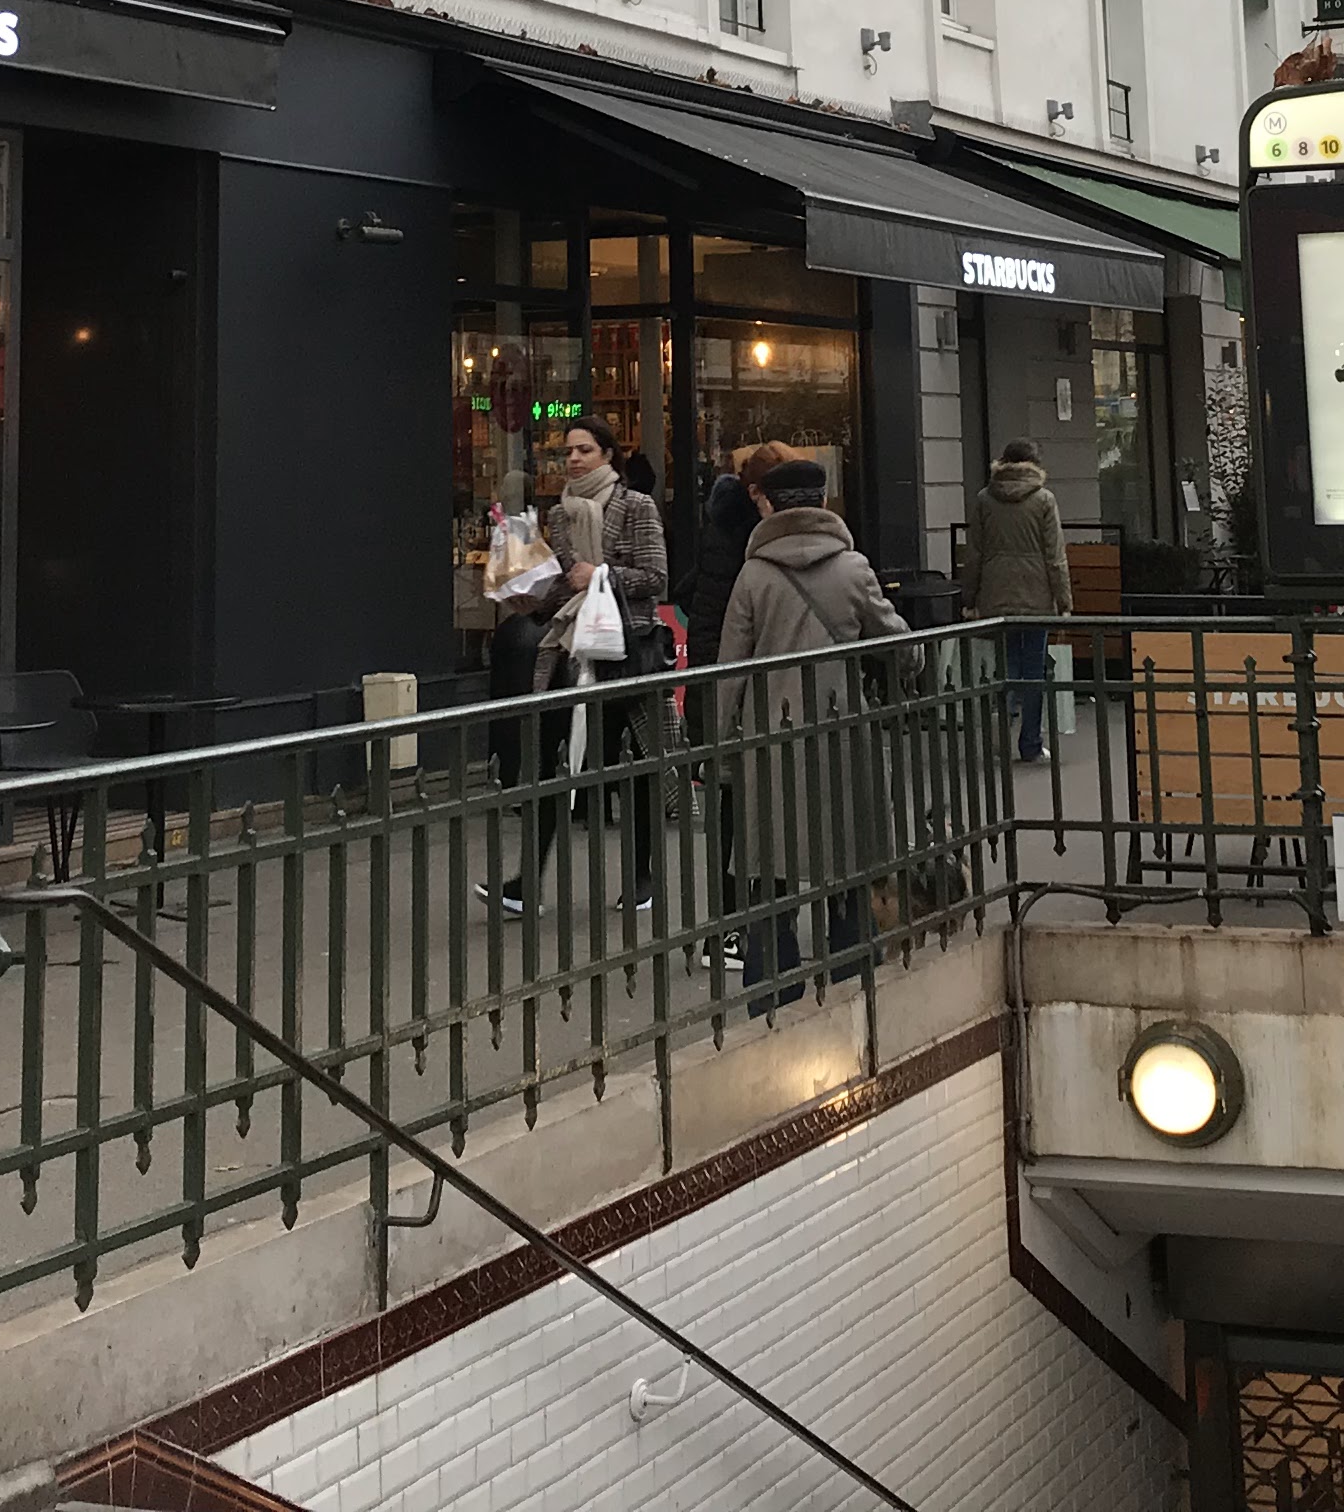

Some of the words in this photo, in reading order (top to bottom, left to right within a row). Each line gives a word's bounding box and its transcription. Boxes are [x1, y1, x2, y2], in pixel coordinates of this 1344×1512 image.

[1271, 143, 1282, 157] 6
[1299, 141, 1308, 156] 8
[1321, 139, 1339, 155] 10
[962, 251, 1056, 294] STARBUCKS
